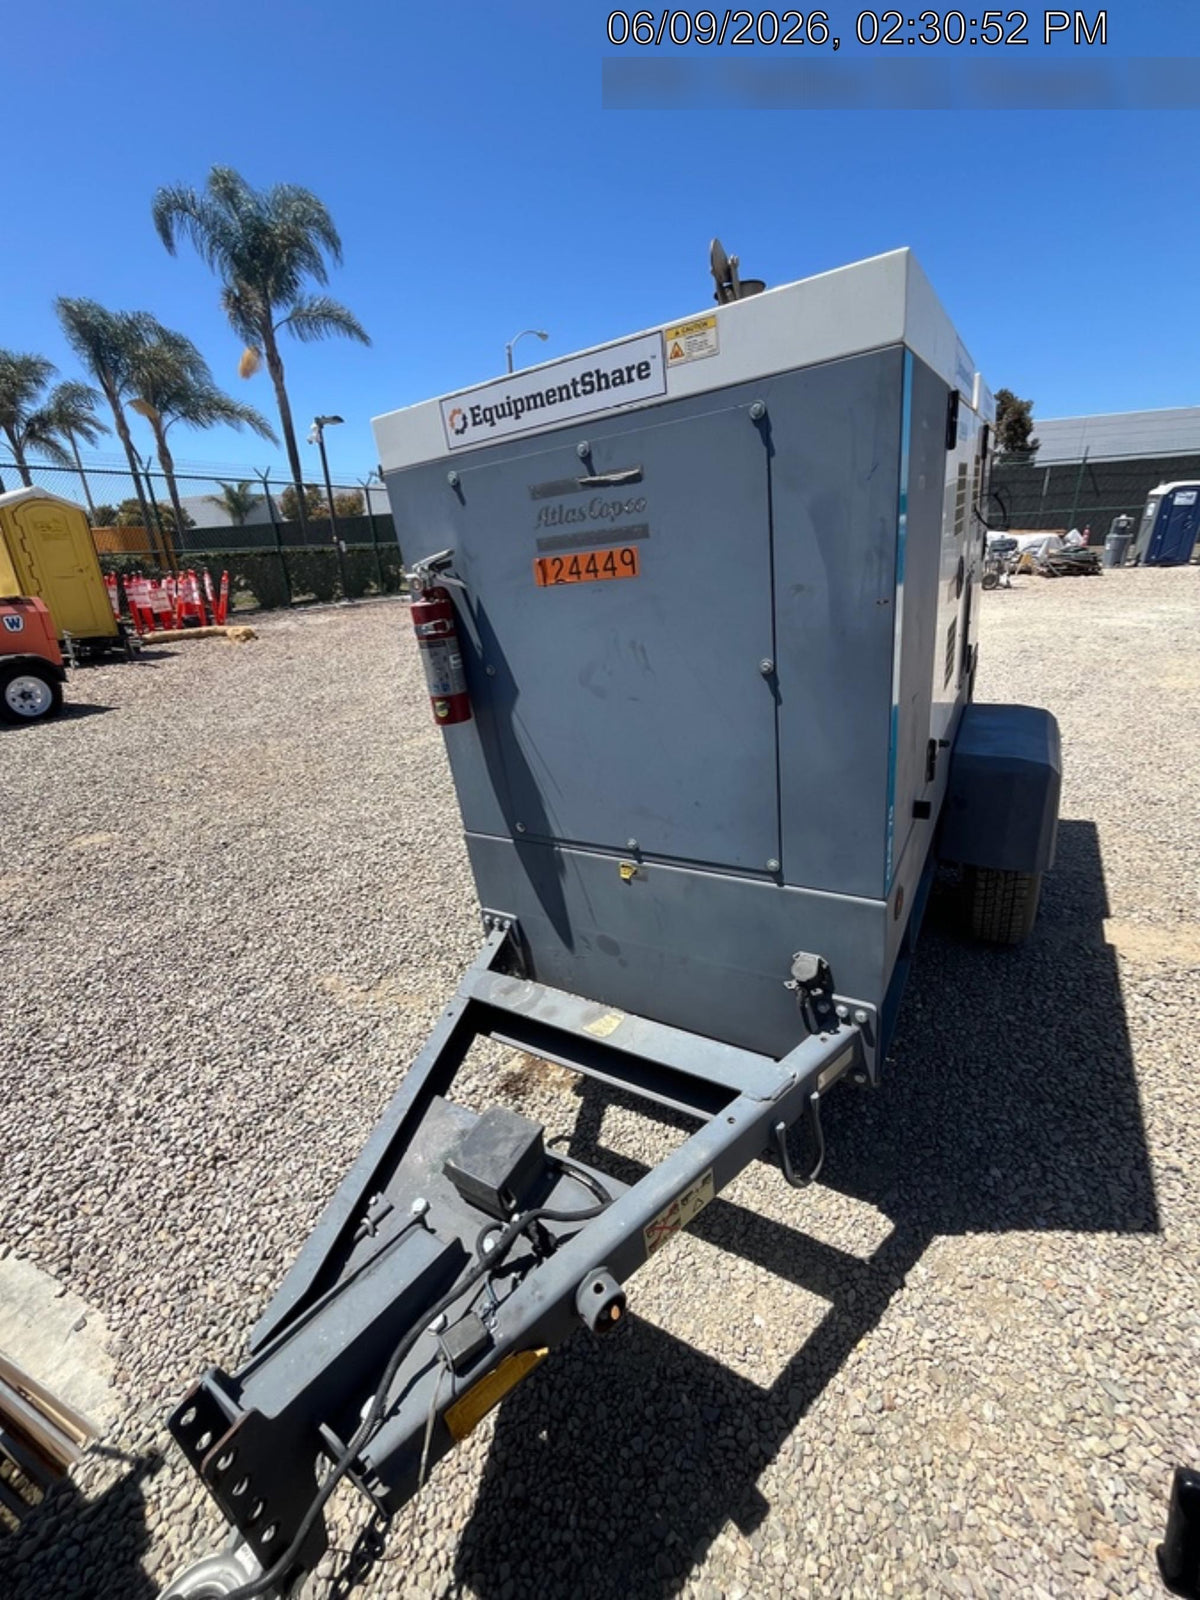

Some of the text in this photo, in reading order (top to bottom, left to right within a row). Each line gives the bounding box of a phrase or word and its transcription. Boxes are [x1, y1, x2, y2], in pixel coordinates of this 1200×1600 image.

[469, 359, 651, 427] EquipmentShare
[535, 496, 647, 529] Atlas Copco
[538, 548, 636, 587] 124449
[5, 617, 20, 630] W
